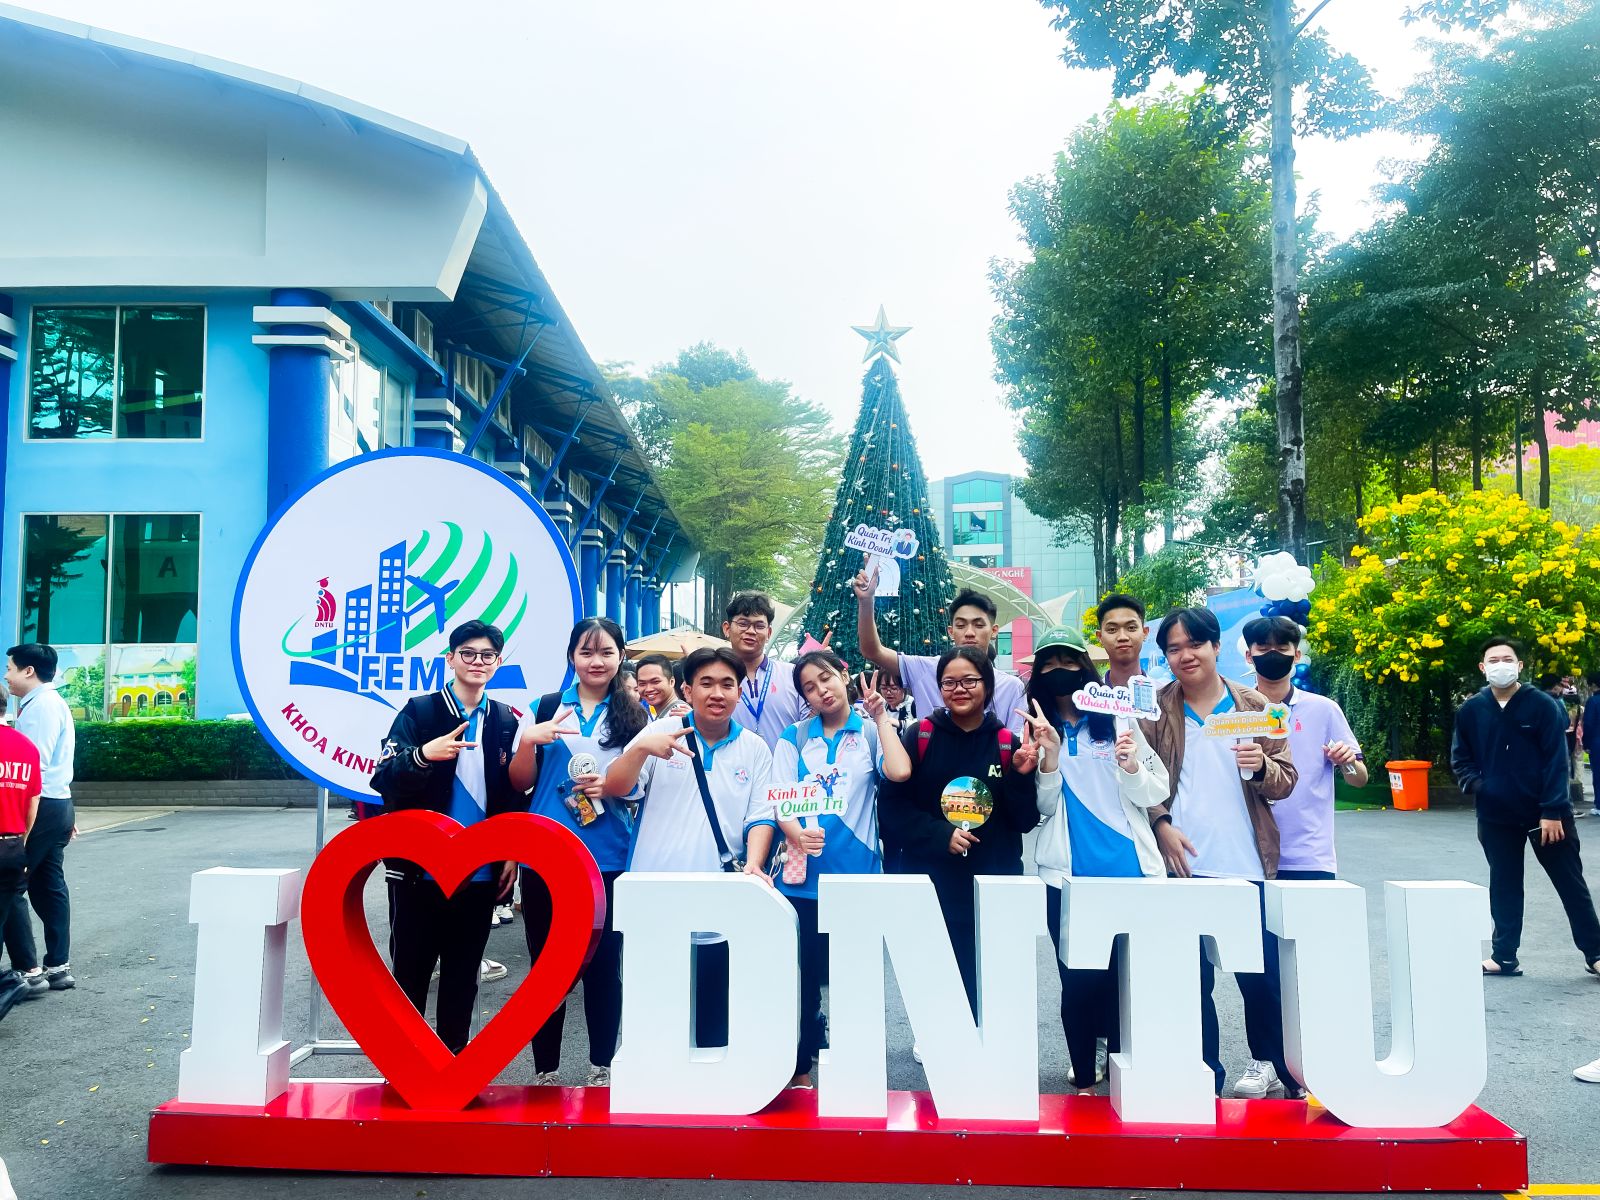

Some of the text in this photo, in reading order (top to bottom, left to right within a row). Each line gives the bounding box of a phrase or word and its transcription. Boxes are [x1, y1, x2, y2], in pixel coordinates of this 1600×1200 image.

[847, 535, 893, 555] Kinh Doanh
[360, 656, 445, 691] FEM
[1077, 694, 1110, 709] Khách
[281, 702, 329, 755] KHOA
[767, 787, 797, 801] Kinh
[780, 796, 843, 817] Quản Trị
[177, 866, 1491, 1128] I DNTU
